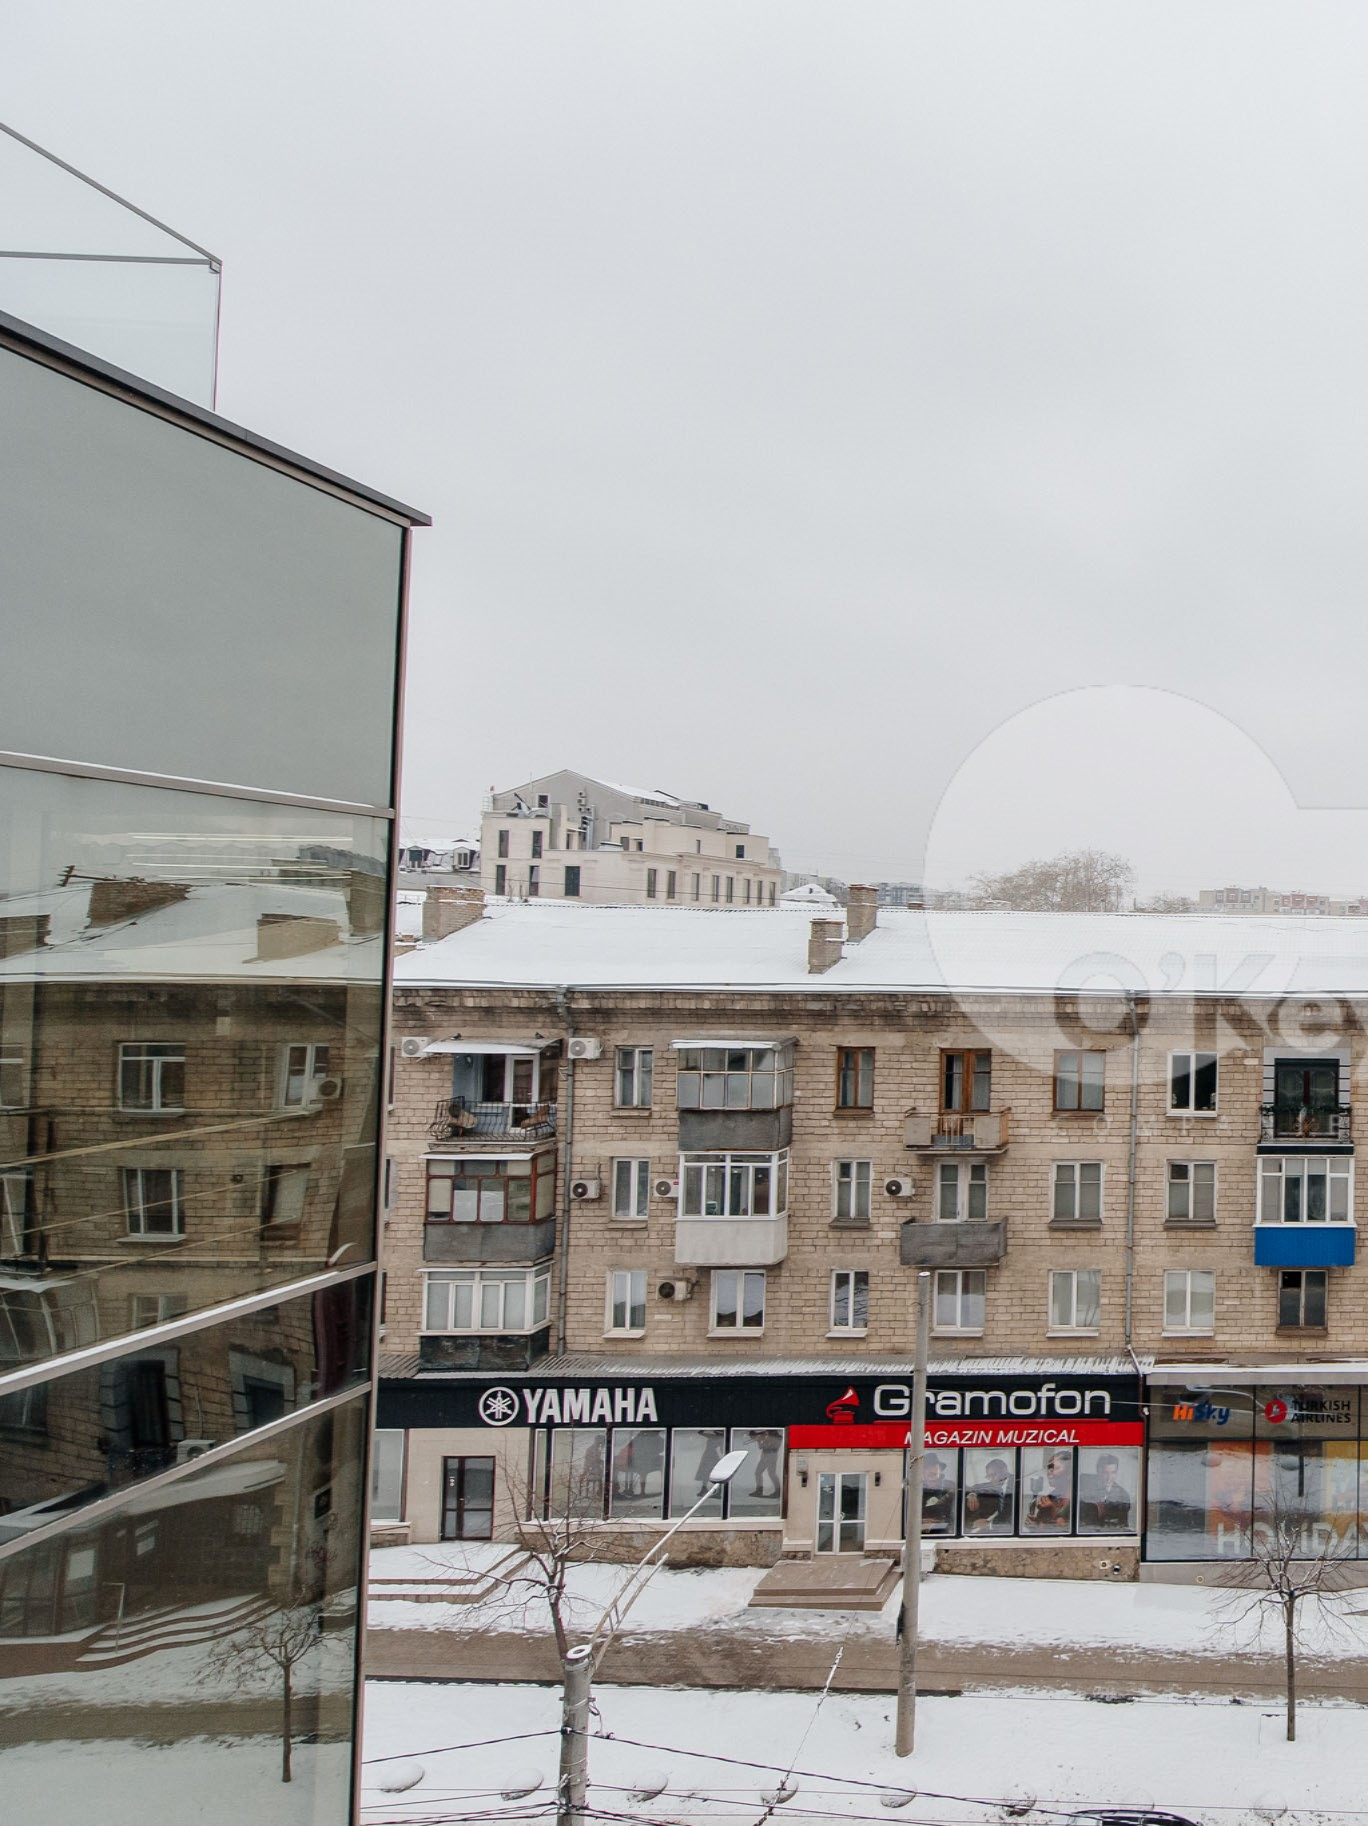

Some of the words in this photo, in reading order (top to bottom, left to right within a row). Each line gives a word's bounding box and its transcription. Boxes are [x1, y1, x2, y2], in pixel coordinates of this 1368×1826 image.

[523, 1388, 658, 1423] YAMAHA
[1291, 1401, 1350, 1411] TURKISH
[1173, 1403, 1231, 1425] HiSky
[1291, 1413, 1351, 1424] AIRLINES
[996, 1430, 1080, 1443] MUZICAL
